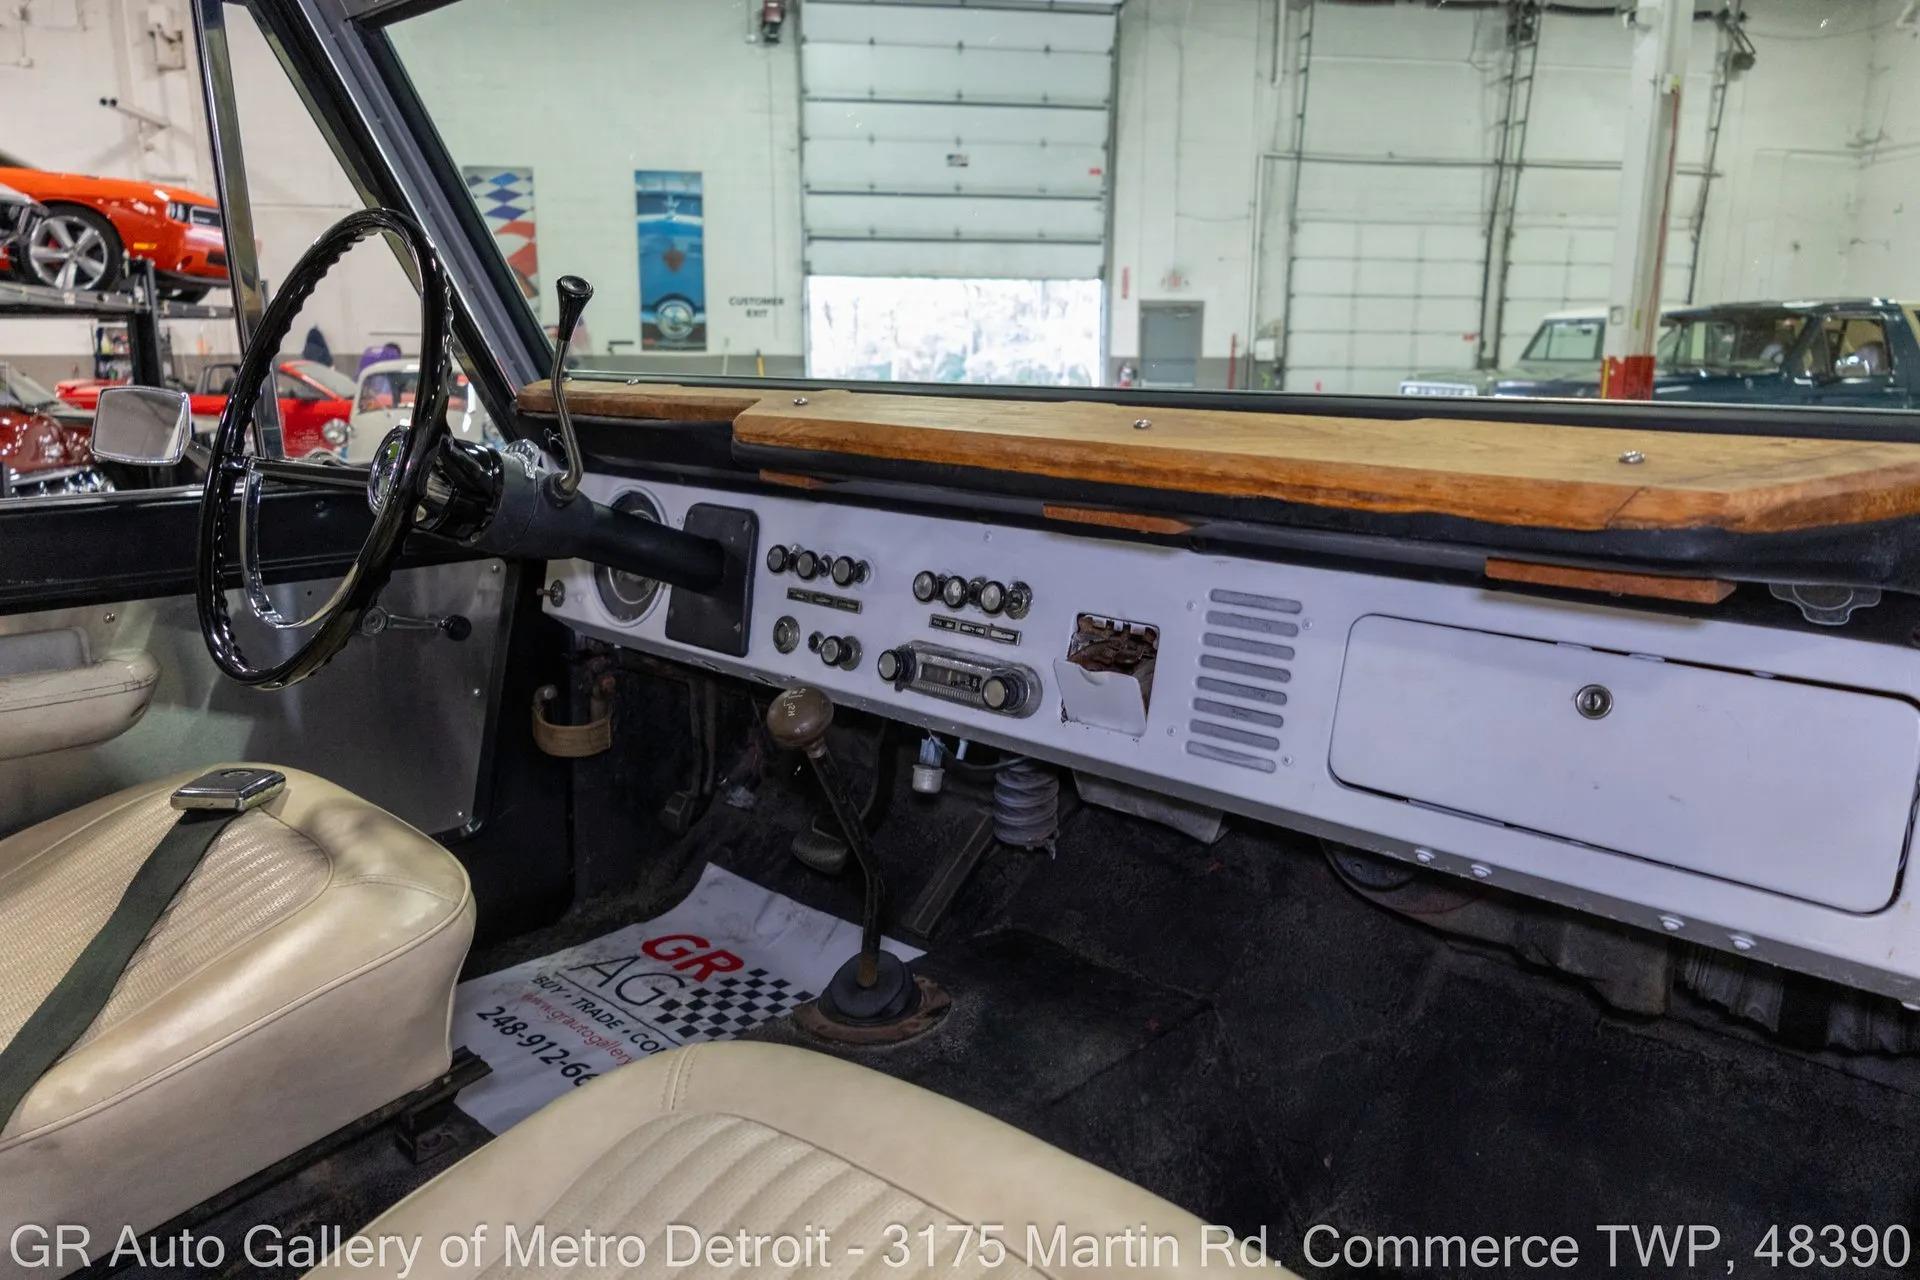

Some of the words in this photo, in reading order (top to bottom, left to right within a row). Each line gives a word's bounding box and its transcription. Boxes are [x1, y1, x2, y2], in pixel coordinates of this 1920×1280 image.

[728, 296, 785, 306] CUSTOMER
[746, 308, 768, 318] EXIT
[568, 955, 686, 1006] AG
[641, 934, 745, 982] GR
[532, 973, 566, 998] BUY
[571, 997, 625, 1030] TRADE
